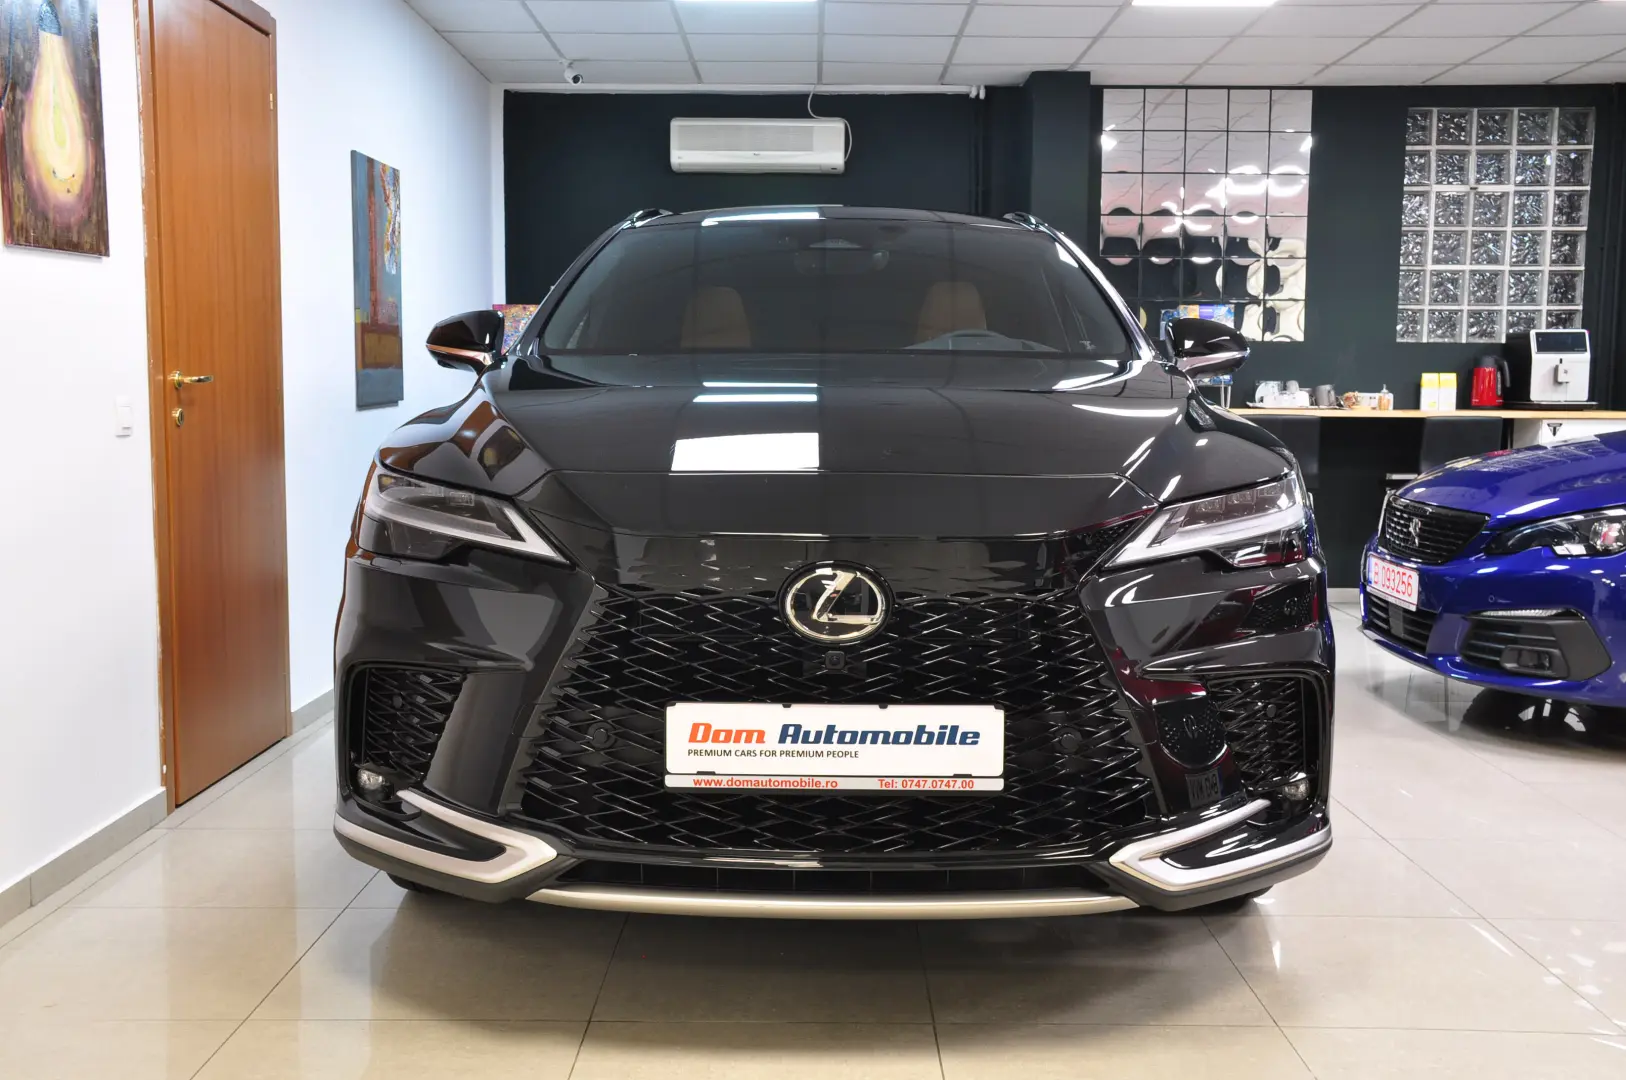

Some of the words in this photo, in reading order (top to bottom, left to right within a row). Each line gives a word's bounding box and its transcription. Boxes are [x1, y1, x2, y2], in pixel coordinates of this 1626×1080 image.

[1382, 566, 1412, 597] 093256
[688, 722, 766, 744] Dom
[778, 723, 981, 746] Automobile
[687, 749, 732, 757] PREMIUM
[734, 749, 758, 758] CARS
[759, 750, 777, 758] FOR
[779, 750, 824, 758] PREMIUM
[826, 750, 859, 759] PEOPLE
[692, 777, 838, 789] www.domautomobile.ro
[878, 779, 898, 789] Tel:
[901, 779, 975, 789] 0747.0747.00
